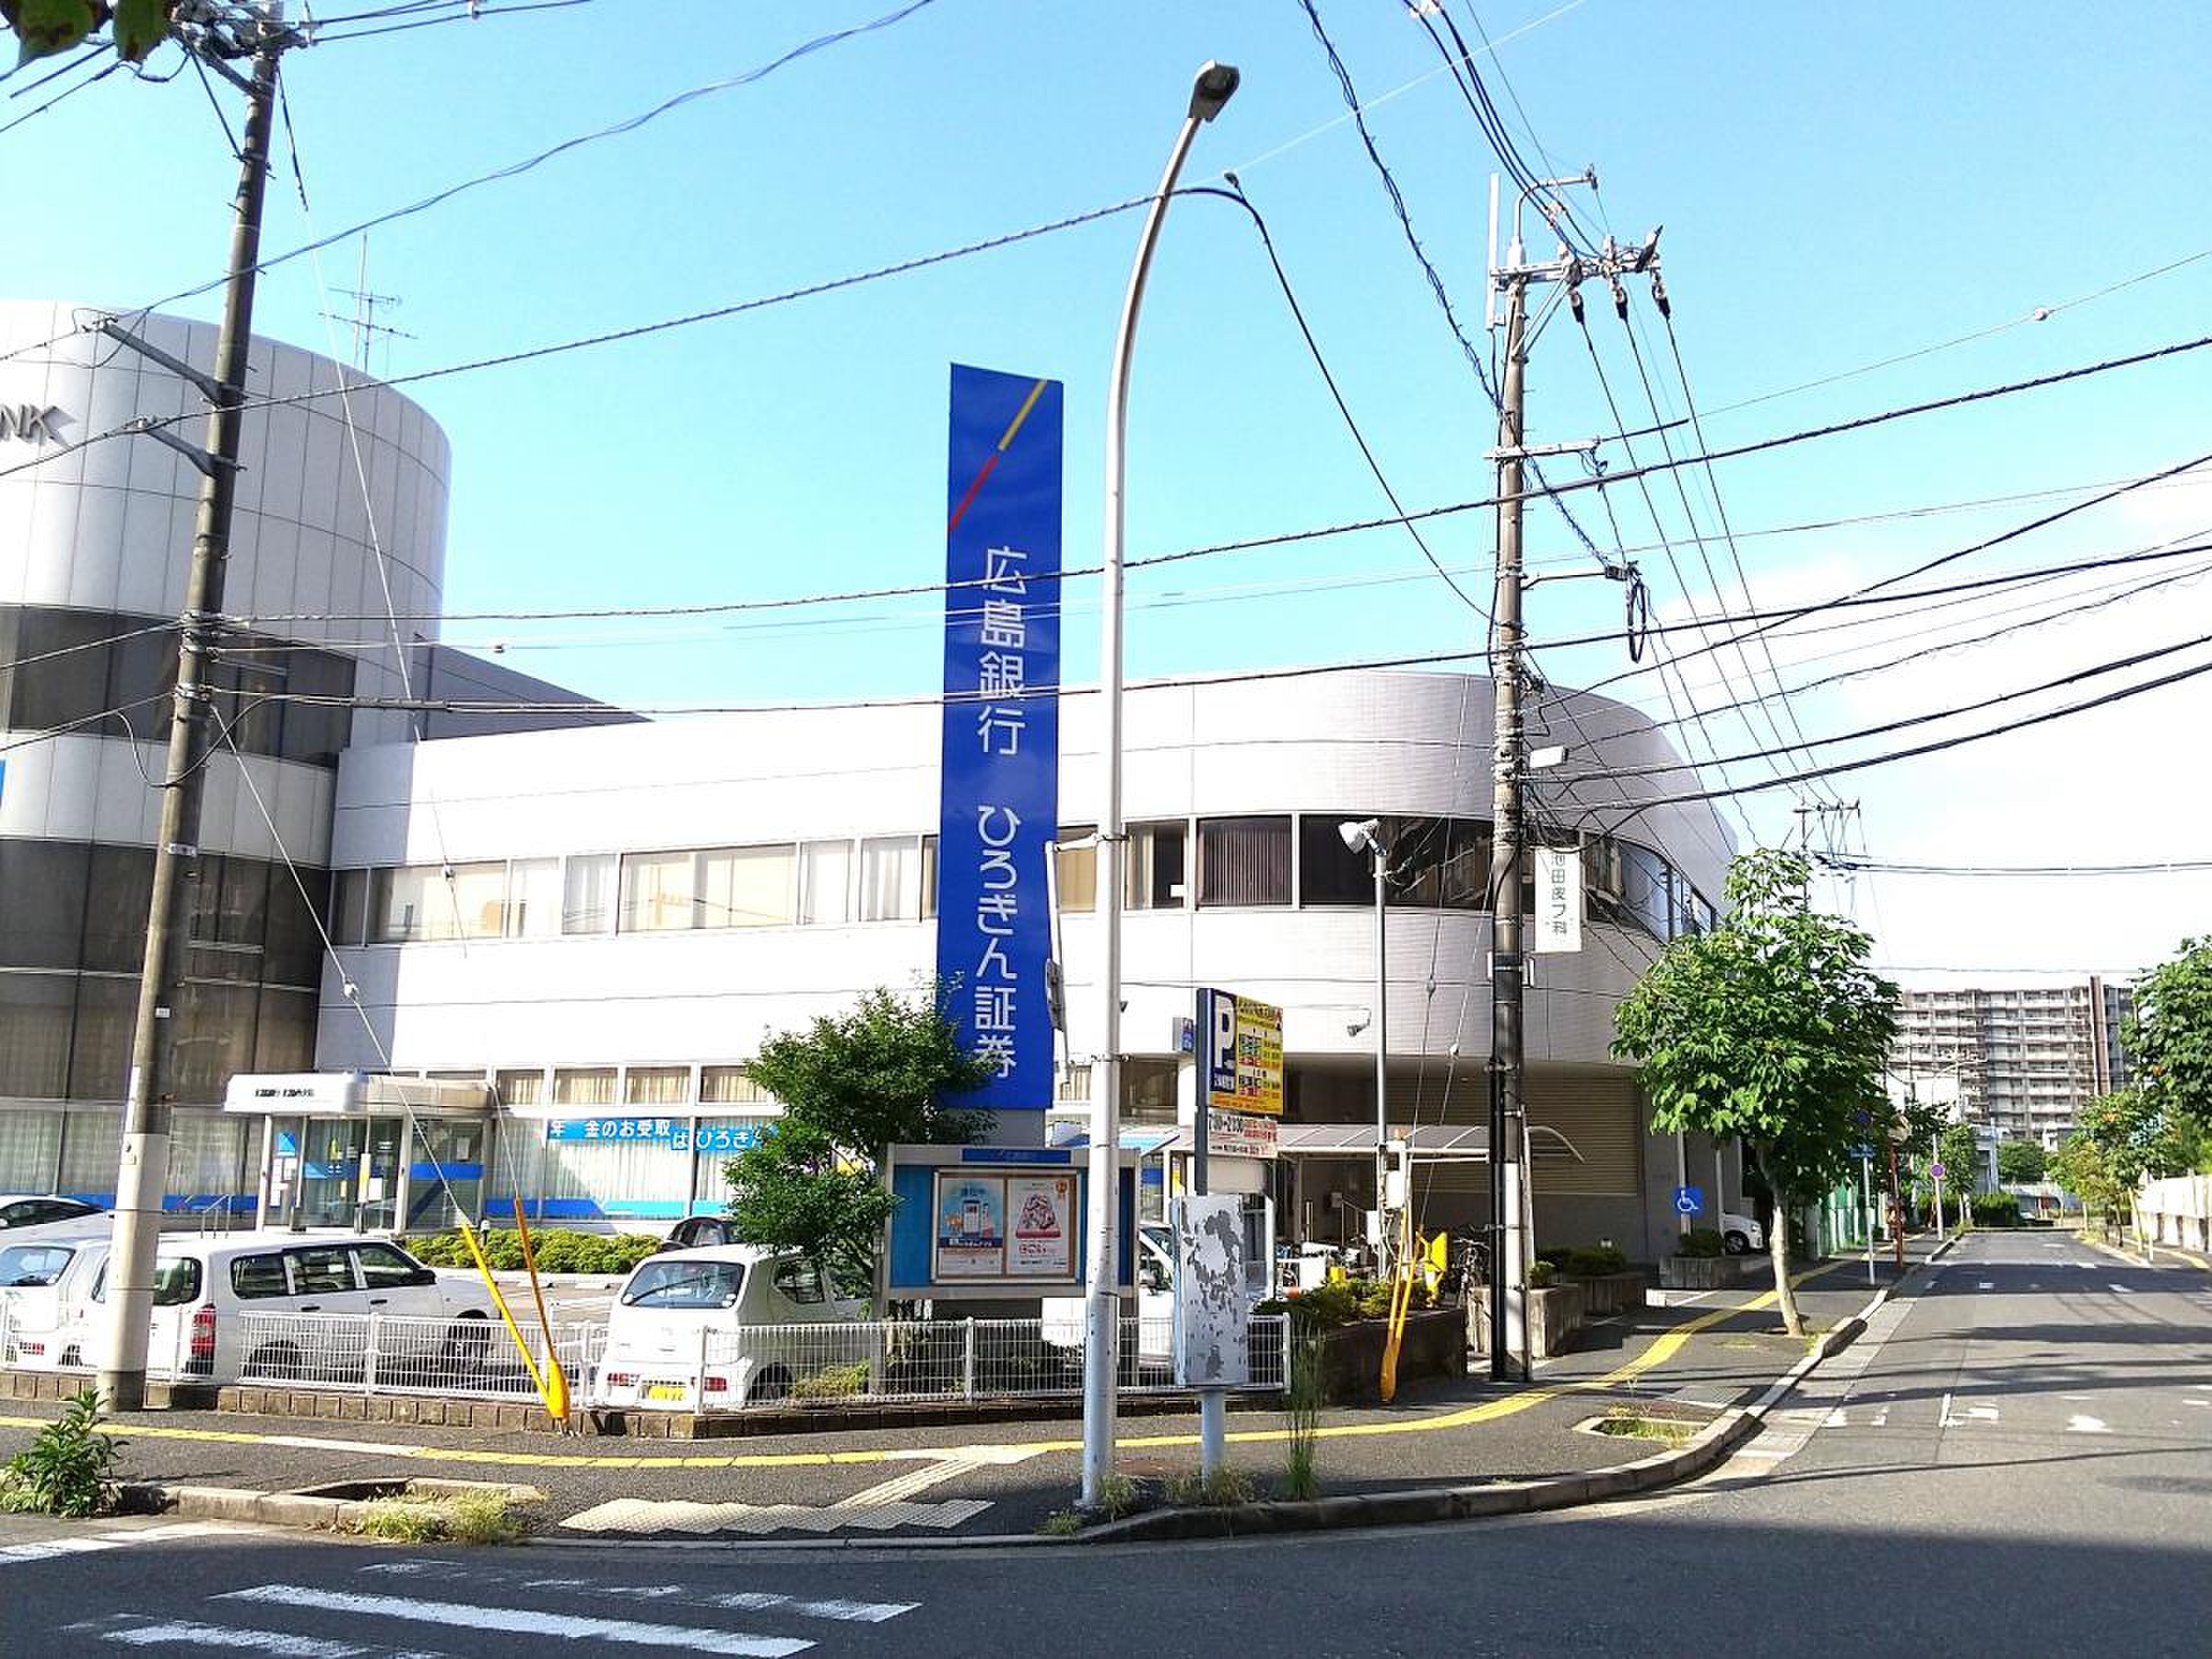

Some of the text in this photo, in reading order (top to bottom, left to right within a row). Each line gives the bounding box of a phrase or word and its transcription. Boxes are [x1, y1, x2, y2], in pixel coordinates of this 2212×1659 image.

[973, 545, 1029, 1078] 広島銀行 ひろぎん証券
[1214, 994, 1235, 1068] P
